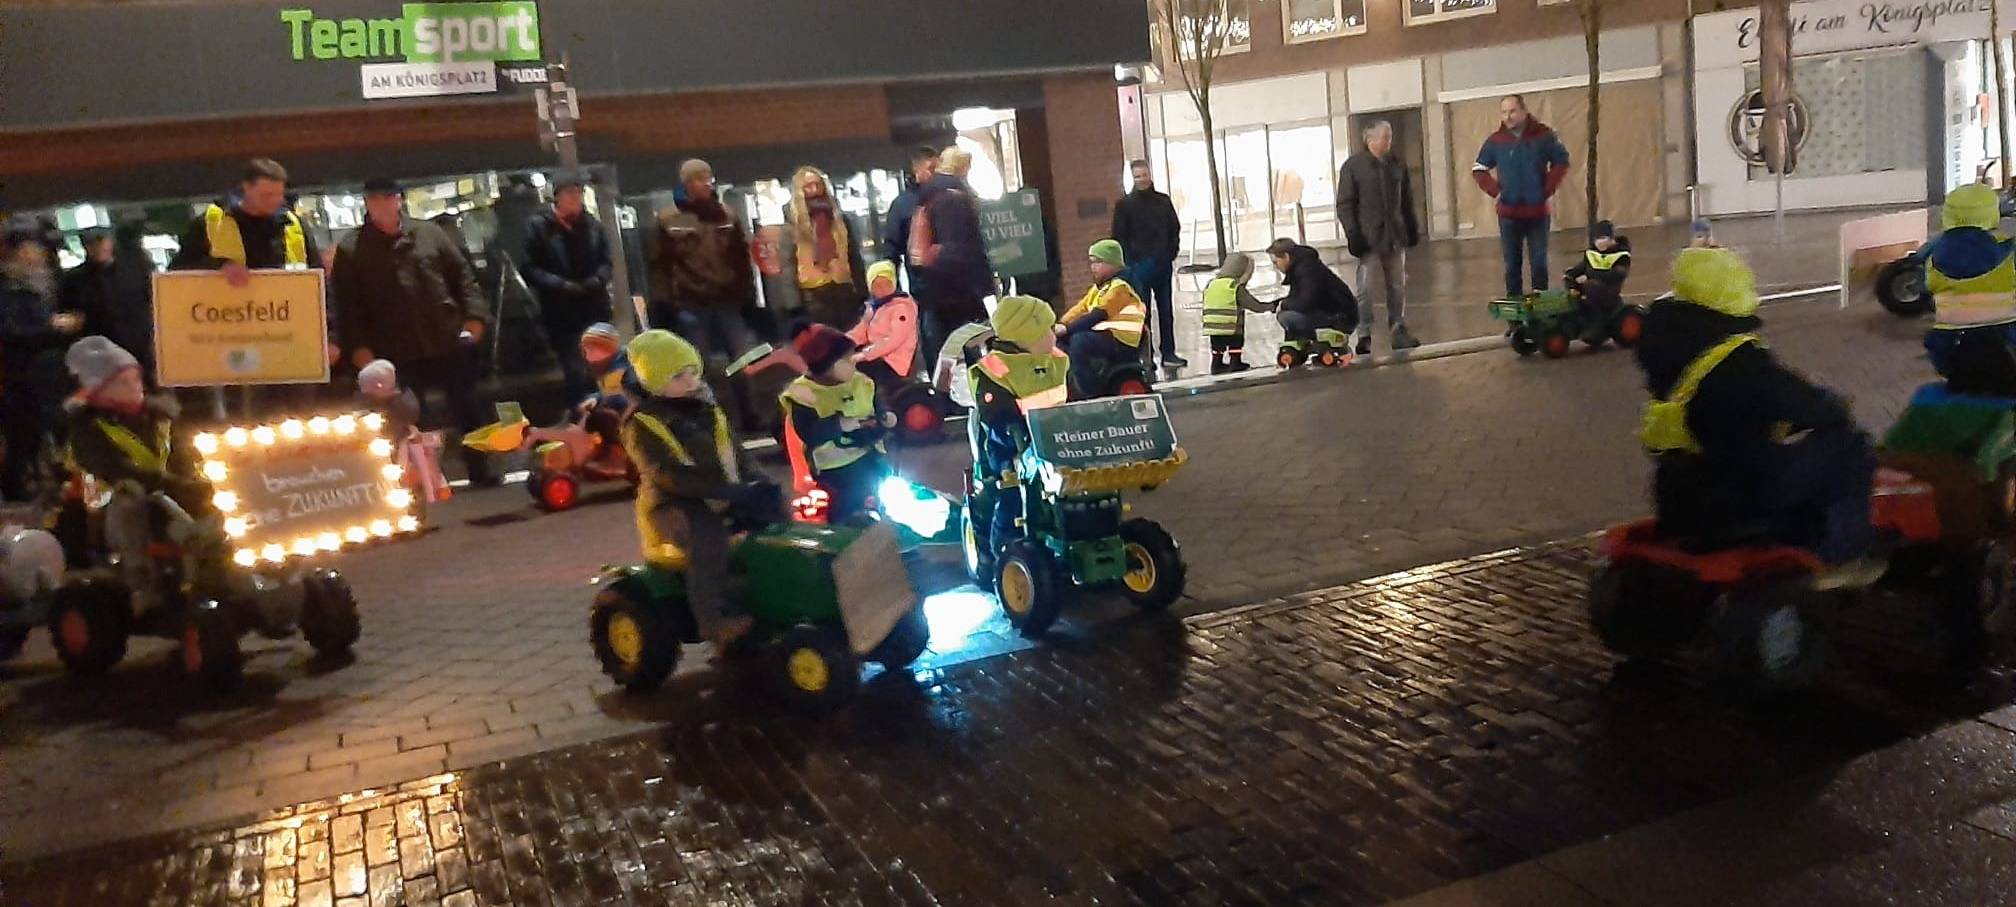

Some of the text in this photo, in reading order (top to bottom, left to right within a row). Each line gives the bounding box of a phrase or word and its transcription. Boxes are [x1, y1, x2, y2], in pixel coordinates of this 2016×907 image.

[1815, 15, 1846, 31] am
[370, 76, 392, 88] AM
[396, 70, 487, 87] KÖNIGSPLATZ
[986, 210, 1017, 225] VIEL
[191, 300, 290, 323] Coesfeld
[1054, 424, 1149, 443] Kleiner Bauer
[1058, 447, 1092, 458] ohne
